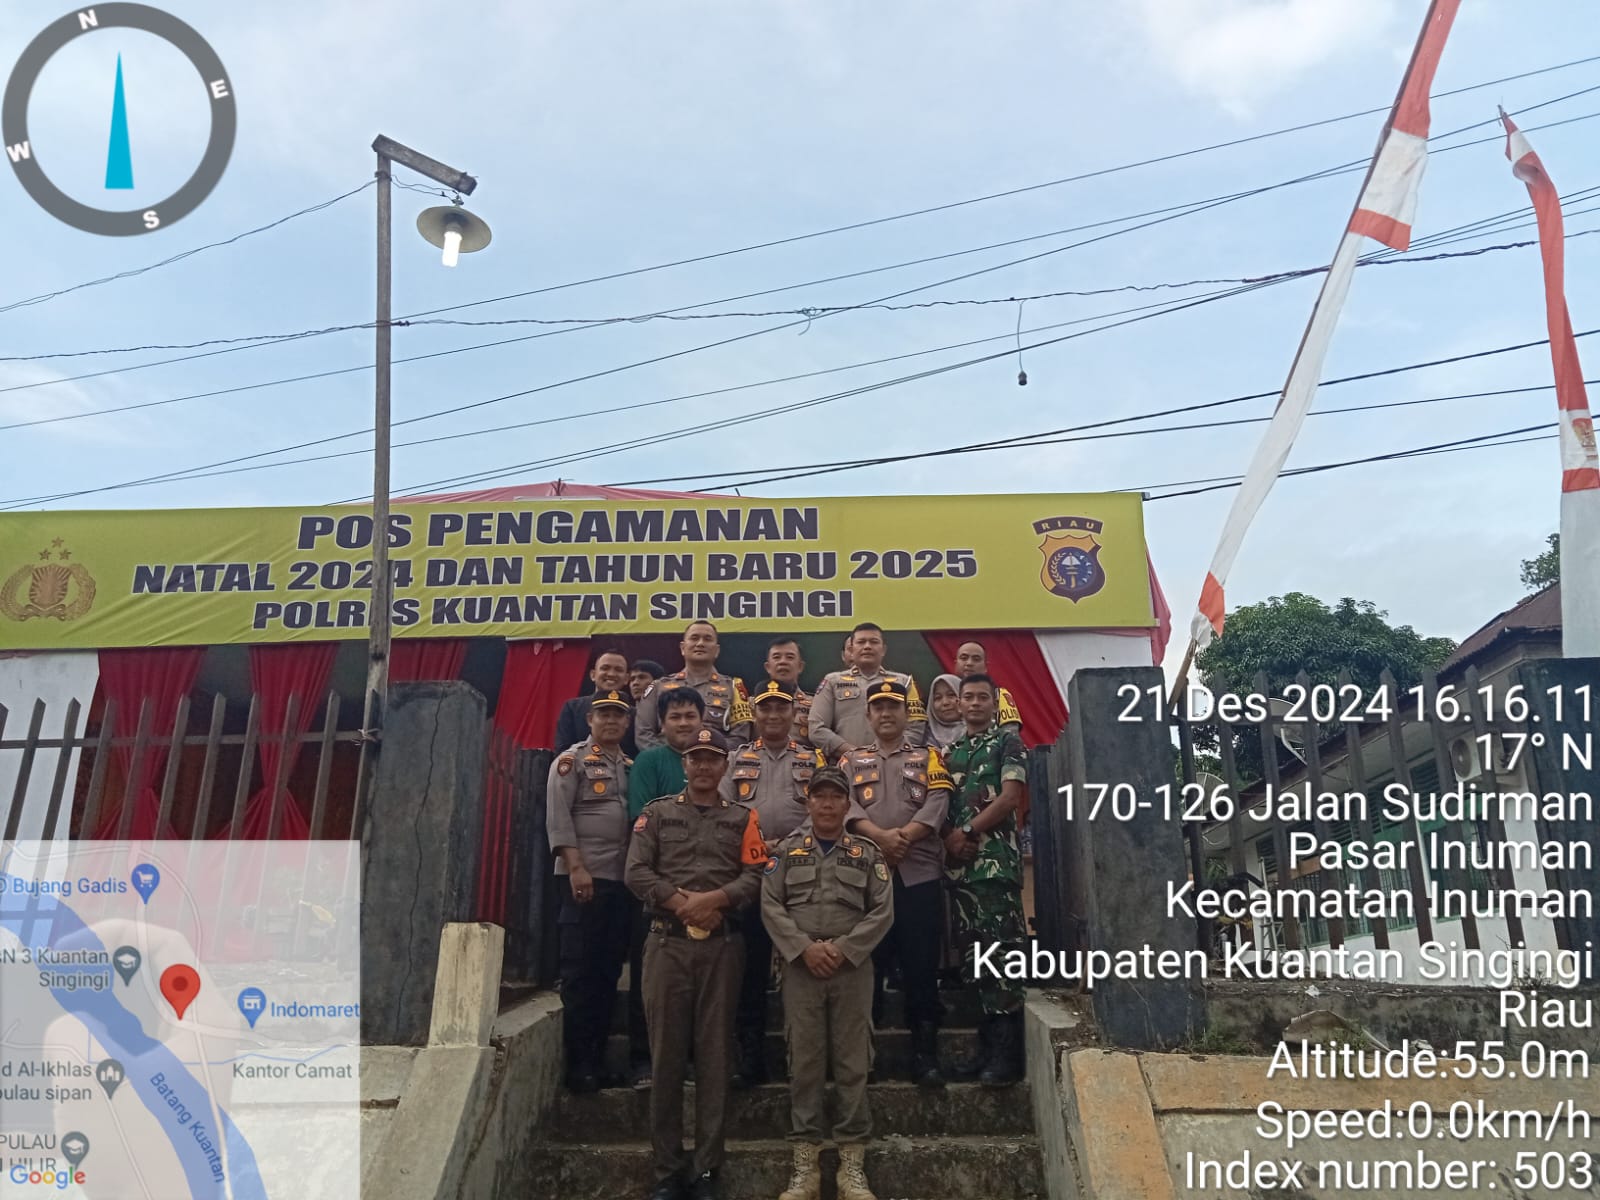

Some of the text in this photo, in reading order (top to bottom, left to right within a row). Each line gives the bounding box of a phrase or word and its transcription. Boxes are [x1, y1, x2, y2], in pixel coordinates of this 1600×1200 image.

[298, 507, 818, 549] POS PENGAMANAN
[1041, 520, 1095, 530] RIAU
[133, 550, 977, 594] NATAL 2024 DAN TAHUN BARU 2025
[252, 590, 852, 629] POLRS KUANTAN SINGINGI
